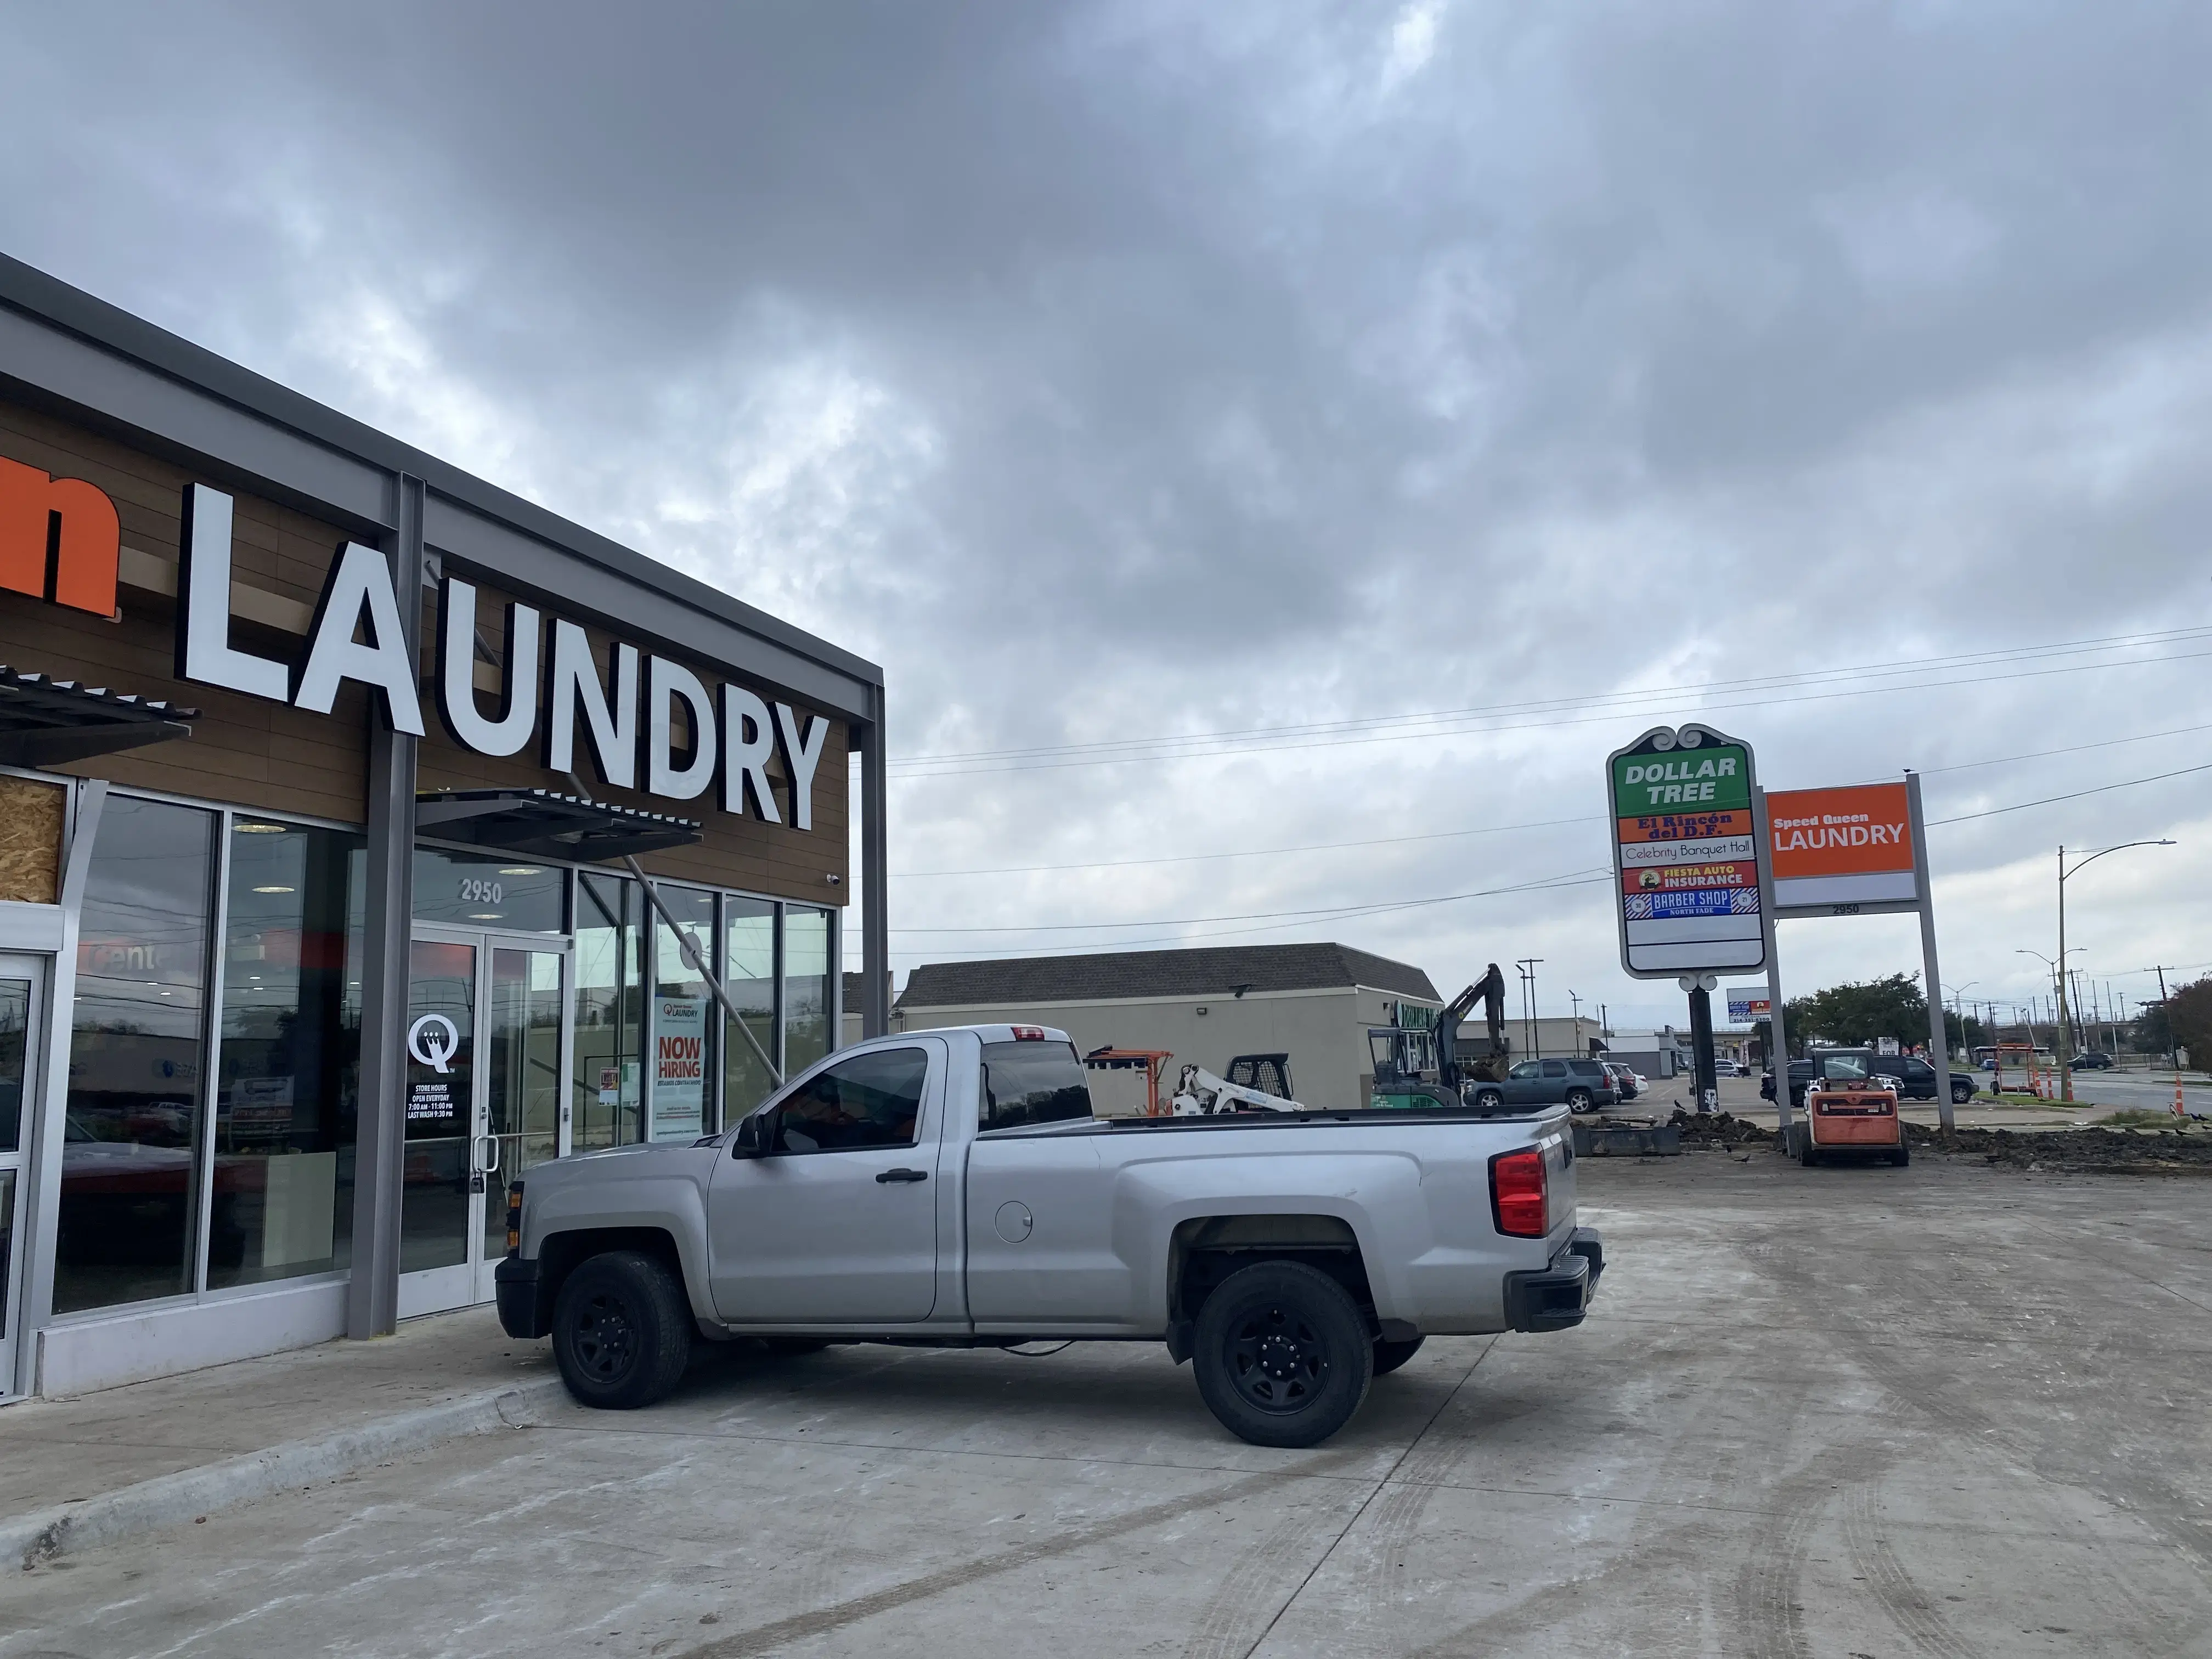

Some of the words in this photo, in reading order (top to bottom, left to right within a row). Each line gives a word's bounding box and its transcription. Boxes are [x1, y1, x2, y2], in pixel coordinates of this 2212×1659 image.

[174, 482, 830, 831] LAUNDRY
[1625, 758, 1736, 785] DOLLAR
[1647, 781, 1716, 804] TREE
[1638, 817, 1657, 829] El
[1662, 812, 1732, 827] Rincón
[1774, 816, 1819, 830] Speed
[1823, 814, 1869, 825] Queen
[1649, 828, 1678, 839] del
[1684, 824, 1722, 837] D.F.
[1774, 823, 1905, 851] LAUNDRY
[1626, 847, 1677, 860] Celebrity
[1680, 844, 1726, 857] Banquet
[1730, 840, 1750, 853] Hall
[1664, 867, 1701, 877] FIESTA
[1703, 865, 1735, 875] AUTO
[1664, 874, 1743, 888] INSURANCE
[462, 878, 502, 904] 2950
[1654, 892, 1696, 910] BARBER
[1699, 890, 1728, 905] SHOP
[1833, 905, 1859, 915] 2950
[672, 1009, 698, 1018] LAUNDRY
[659, 1036, 701, 1059] NOW
[658, 1061, 701, 1078] HIRING
